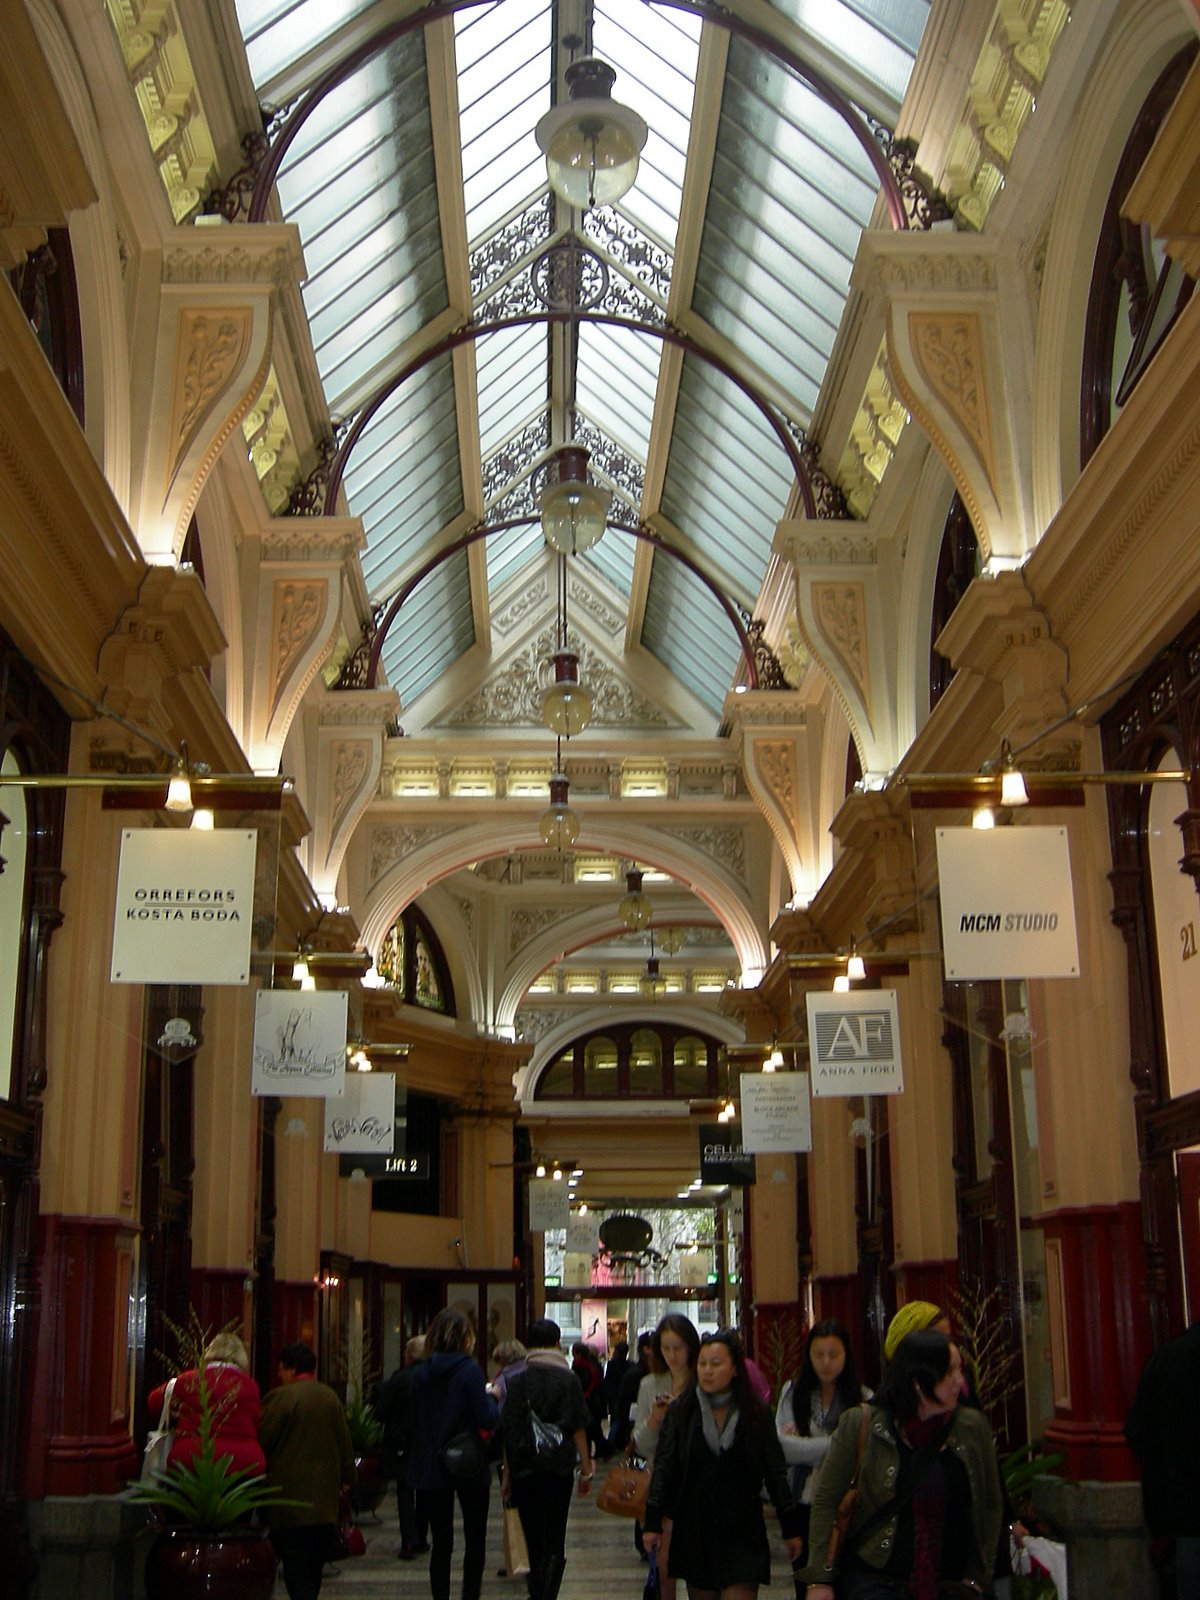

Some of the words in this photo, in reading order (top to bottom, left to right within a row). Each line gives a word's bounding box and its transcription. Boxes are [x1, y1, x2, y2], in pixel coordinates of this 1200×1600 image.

[135, 888, 236, 902] ORREFORS
[127, 908, 184, 921] KOSTA
[191, 908, 240, 922] BODA
[960, 913, 1001, 932] MCM
[1004, 912, 1058, 931] STUDIO
[1180, 921, 1198, 961] 21
[827, 1015, 886, 1057] AF
[819, 1065, 855, 1077] ANNA
[862, 1064, 895, 1075] FIORI
[703, 1144, 744, 1155] CELLI
[385, 1158, 407, 1173] Lift
[410, 1158, 418, 1172] 2
